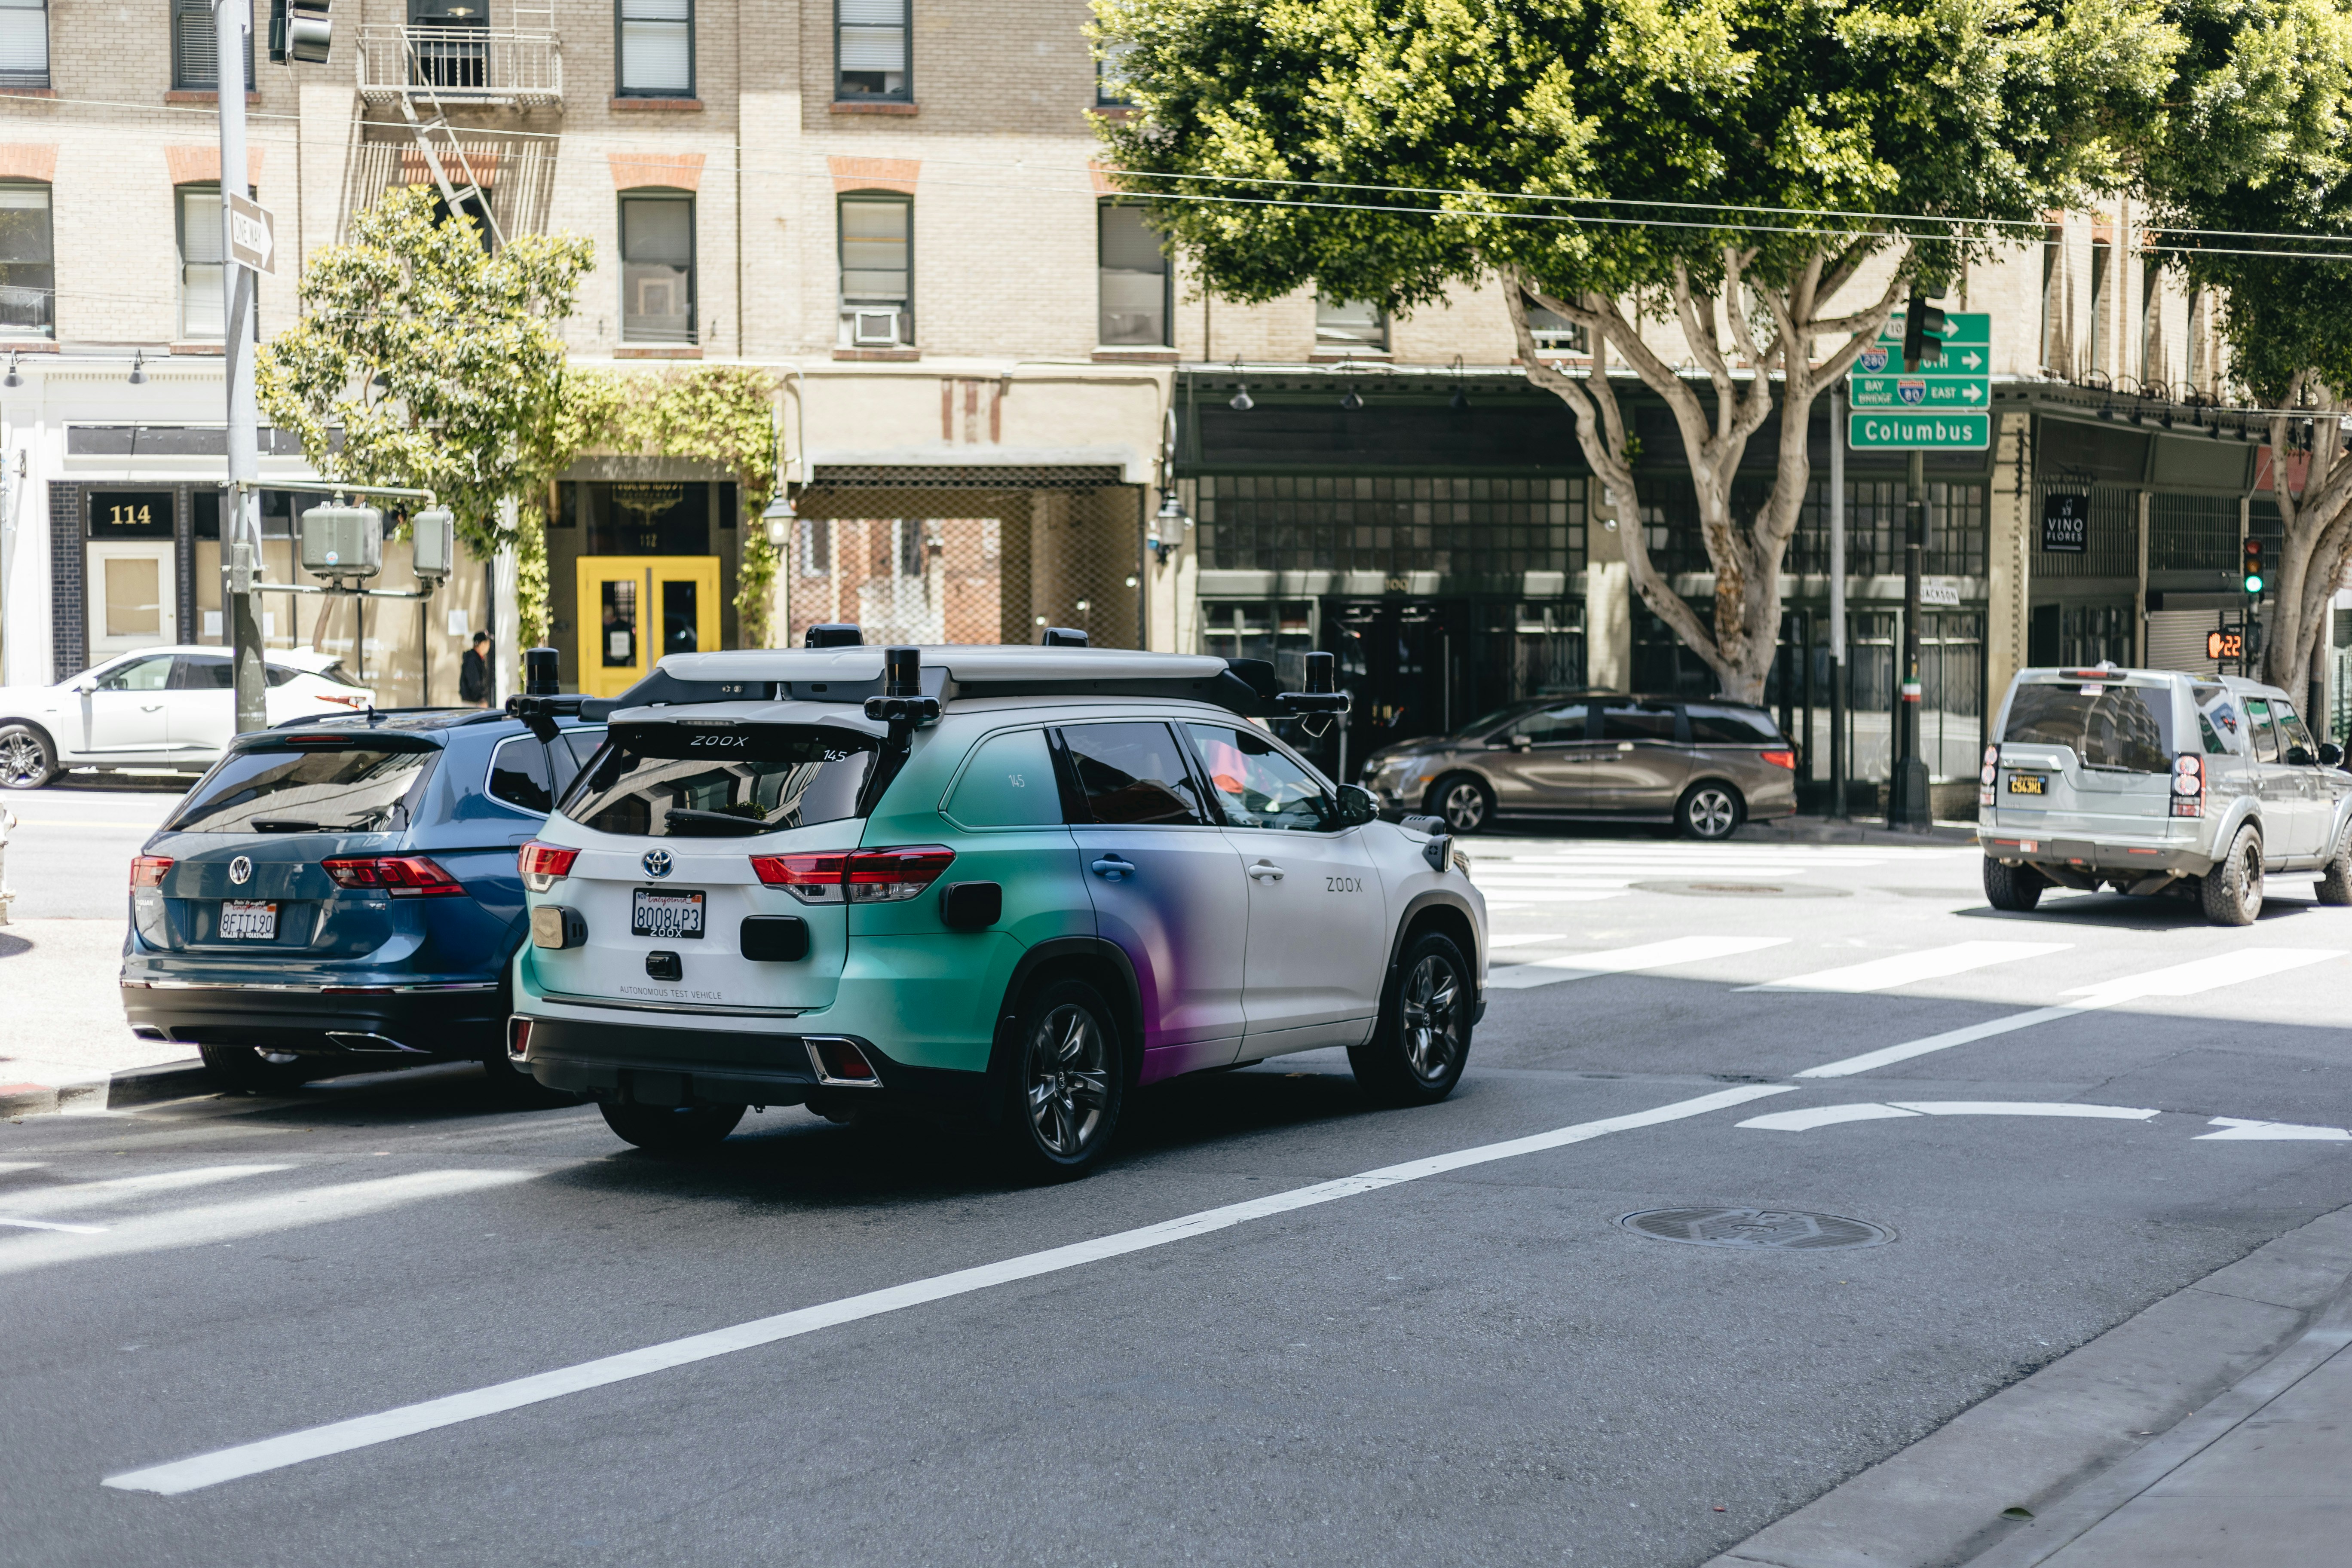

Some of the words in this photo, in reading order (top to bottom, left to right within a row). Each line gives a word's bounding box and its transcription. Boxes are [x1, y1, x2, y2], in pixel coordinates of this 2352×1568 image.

[235, 215, 248, 244] ONE
[249, 222, 262, 250] WAY
[1864, 380, 1884, 392] BAY
[1858, 392, 1893, 404] BRIDGE
[1904, 389, 1920, 401] 80
[1931, 387, 1956, 399] EAST
[1865, 420, 1973, 441] Columbus
[110, 505, 151, 524] 114
[2048, 517, 2083, 532] VINO
[640, 533, 658, 548] 112
[2046, 530, 2082, 542] FLORES
[1921, 588, 1957, 602] JACKSON
[2224, 635, 2241, 657] 22
[690, 736, 749, 747] ZOOX
[824, 750, 847, 762] 145
[1008, 775, 1025, 787] 145
[1326, 877, 1363, 892] ZOOX
[648, 896, 691, 906] California
[222, 914, 272, 933] 8FIT190
[637, 906, 698, 930] 80084P3
[650, 928, 682, 937] ZOOX
[620, 986, 668, 996] AUTONOMOUS
[691, 991, 722, 1000] VEHICLE
